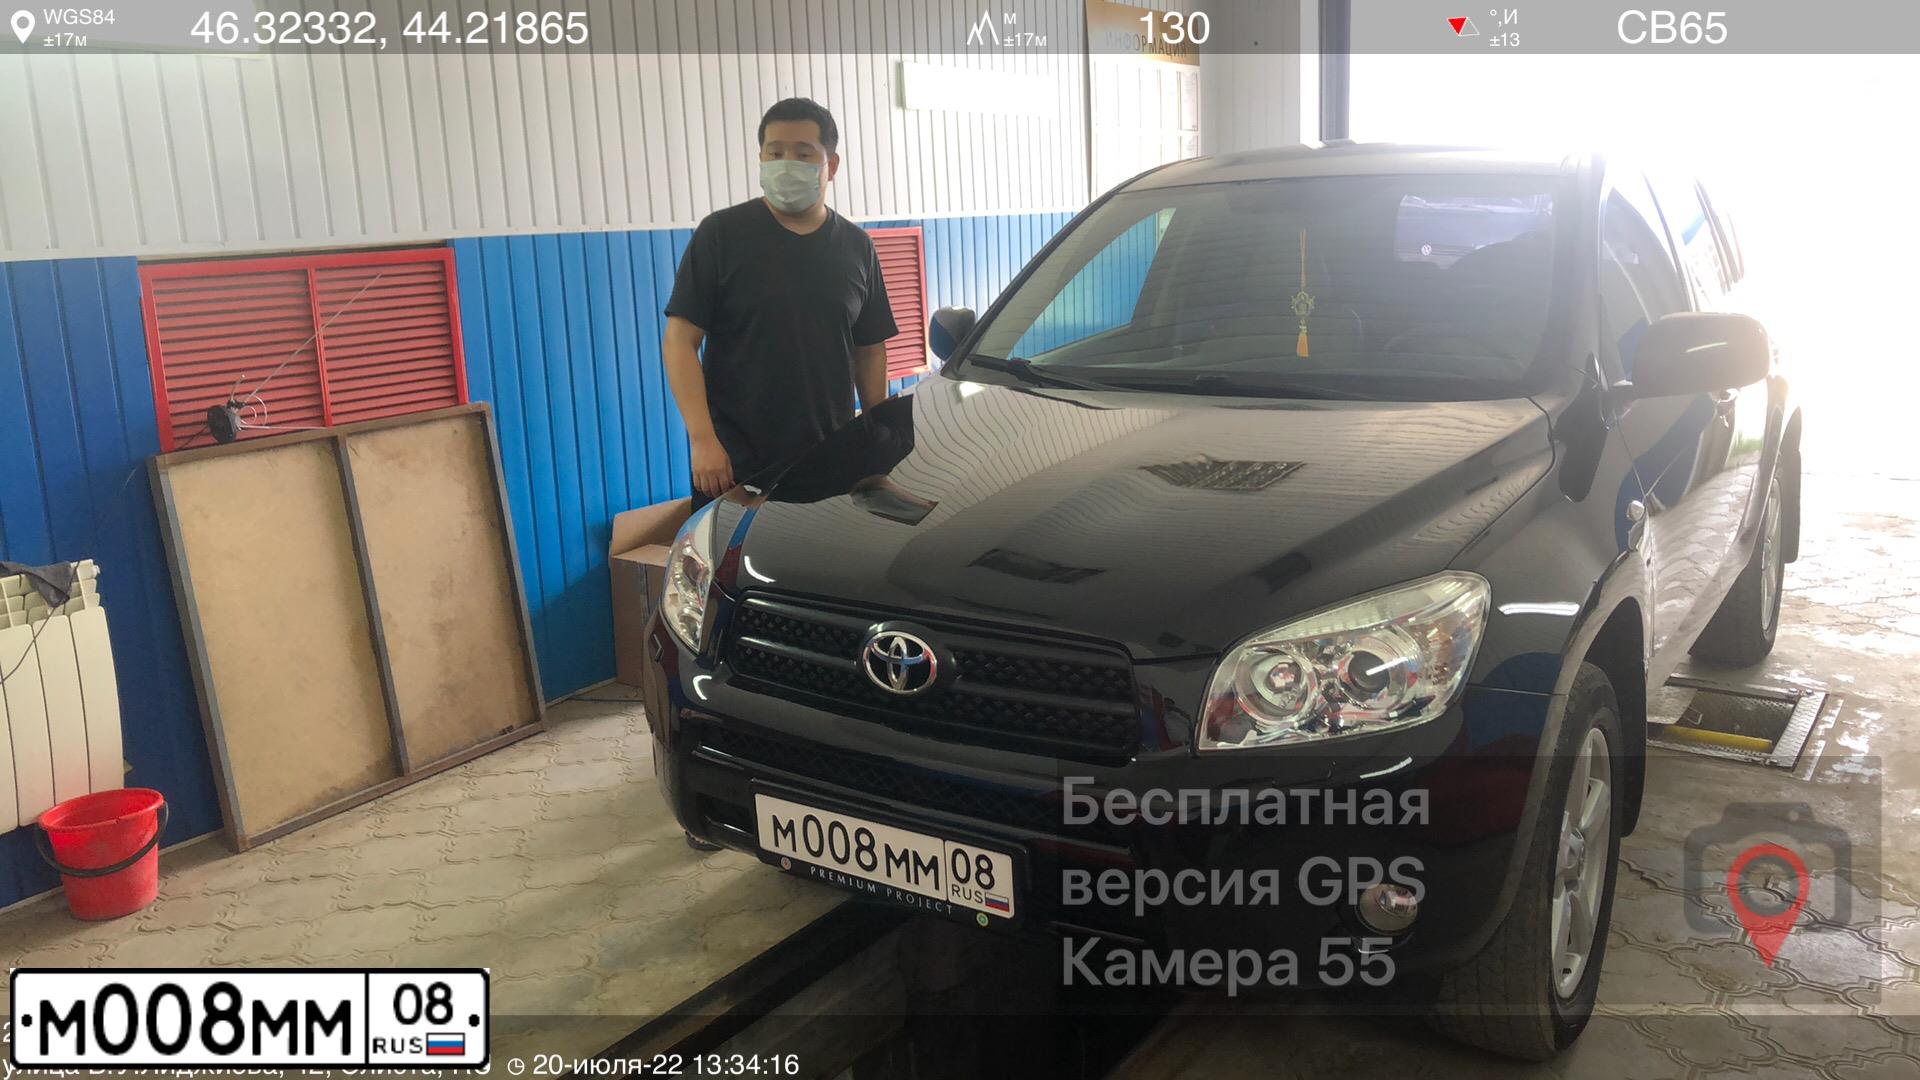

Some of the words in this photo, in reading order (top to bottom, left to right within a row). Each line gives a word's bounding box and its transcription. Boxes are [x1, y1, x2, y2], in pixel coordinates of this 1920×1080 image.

[772, 814, 940, 891] М008ММ
[951, 848, 995, 890] 08
[810, 866, 876, 893] PREMIUM
[886, 888, 953, 915] PROJECT
[951, 883, 984, 904] RUS
